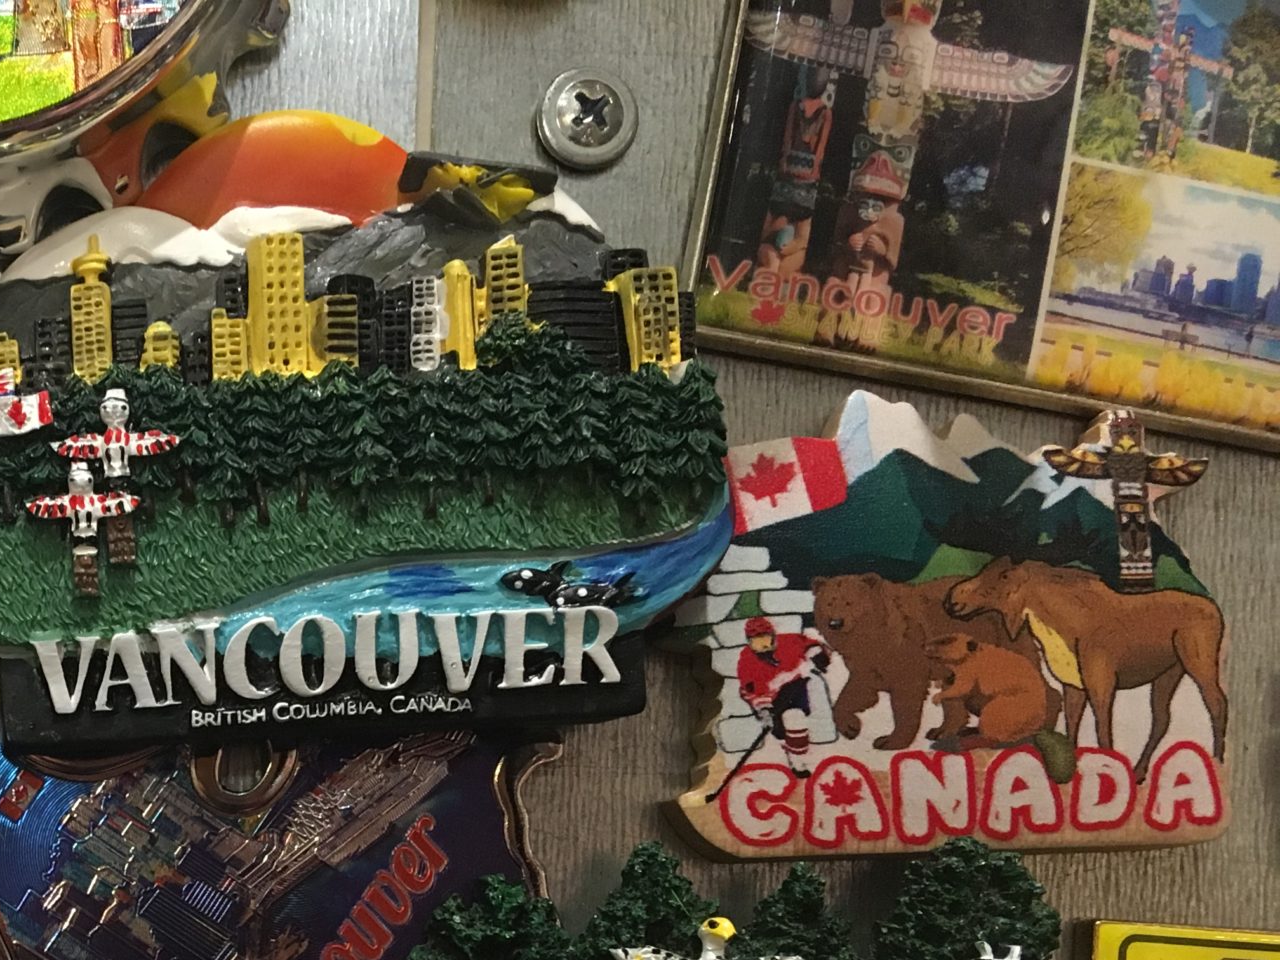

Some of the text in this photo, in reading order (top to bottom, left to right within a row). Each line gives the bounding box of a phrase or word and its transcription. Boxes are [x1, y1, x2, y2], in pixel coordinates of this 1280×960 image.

[707, 255, 1016, 342] Vancouver
[783, 302, 1000, 367] STANLEY PARK
[32, 605, 621, 713] VANCOUVER
[191, 707, 266, 727] BRITISH
[389, 693, 472, 714] CANADA
[720, 740, 1222, 848] CANADA
